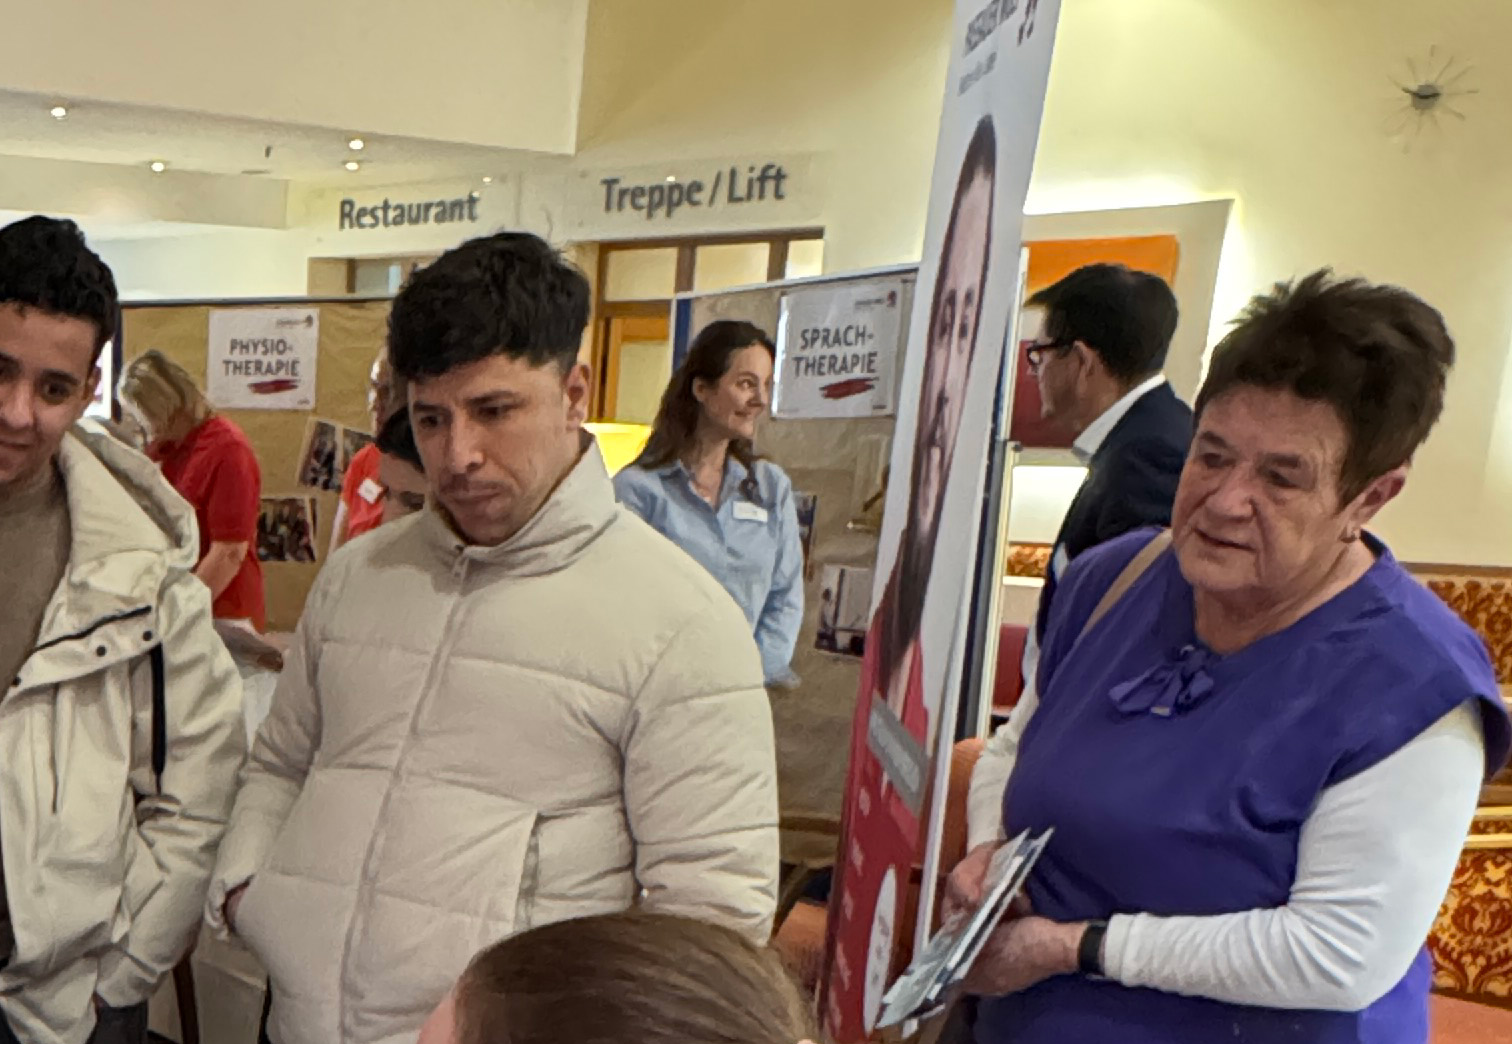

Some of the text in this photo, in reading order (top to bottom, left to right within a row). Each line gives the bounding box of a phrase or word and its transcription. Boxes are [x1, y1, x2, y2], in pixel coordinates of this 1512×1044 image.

[601, 178, 704, 219] Treppe
[727, 164, 787, 203] Lift
[339, 195, 480, 230] Restaurant
[229, 338, 293, 356] PHYSIO-
[800, 325, 875, 350] SPRACH-
[222, 358, 300, 377] THERAPIE
[792, 351, 878, 377] THERAPIE
